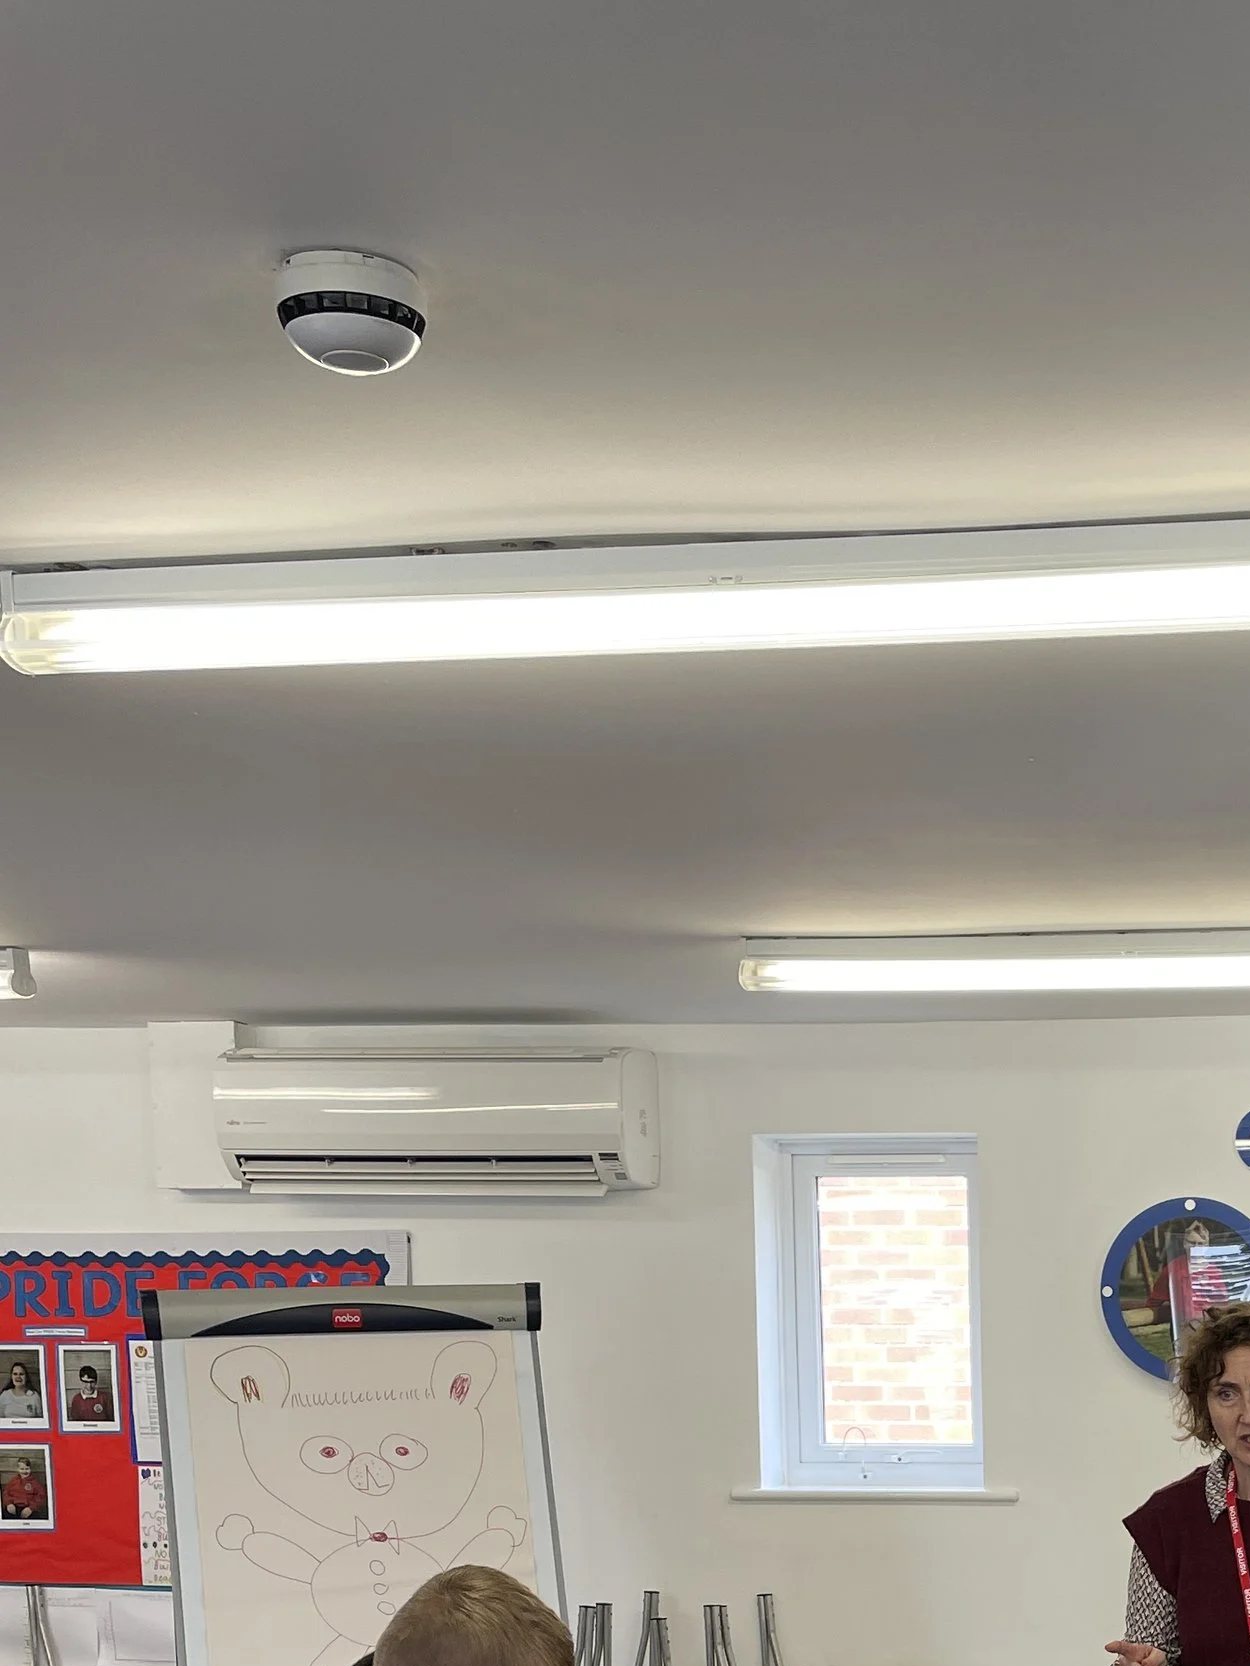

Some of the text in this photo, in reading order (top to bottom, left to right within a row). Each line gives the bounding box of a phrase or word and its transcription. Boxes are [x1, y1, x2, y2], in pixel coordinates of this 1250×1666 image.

[334, 1312, 361, 1323] nobo
[1229, 1505, 1239, 1534] VISITOR
[1236, 1547, 1248, 1576] VISITOR
